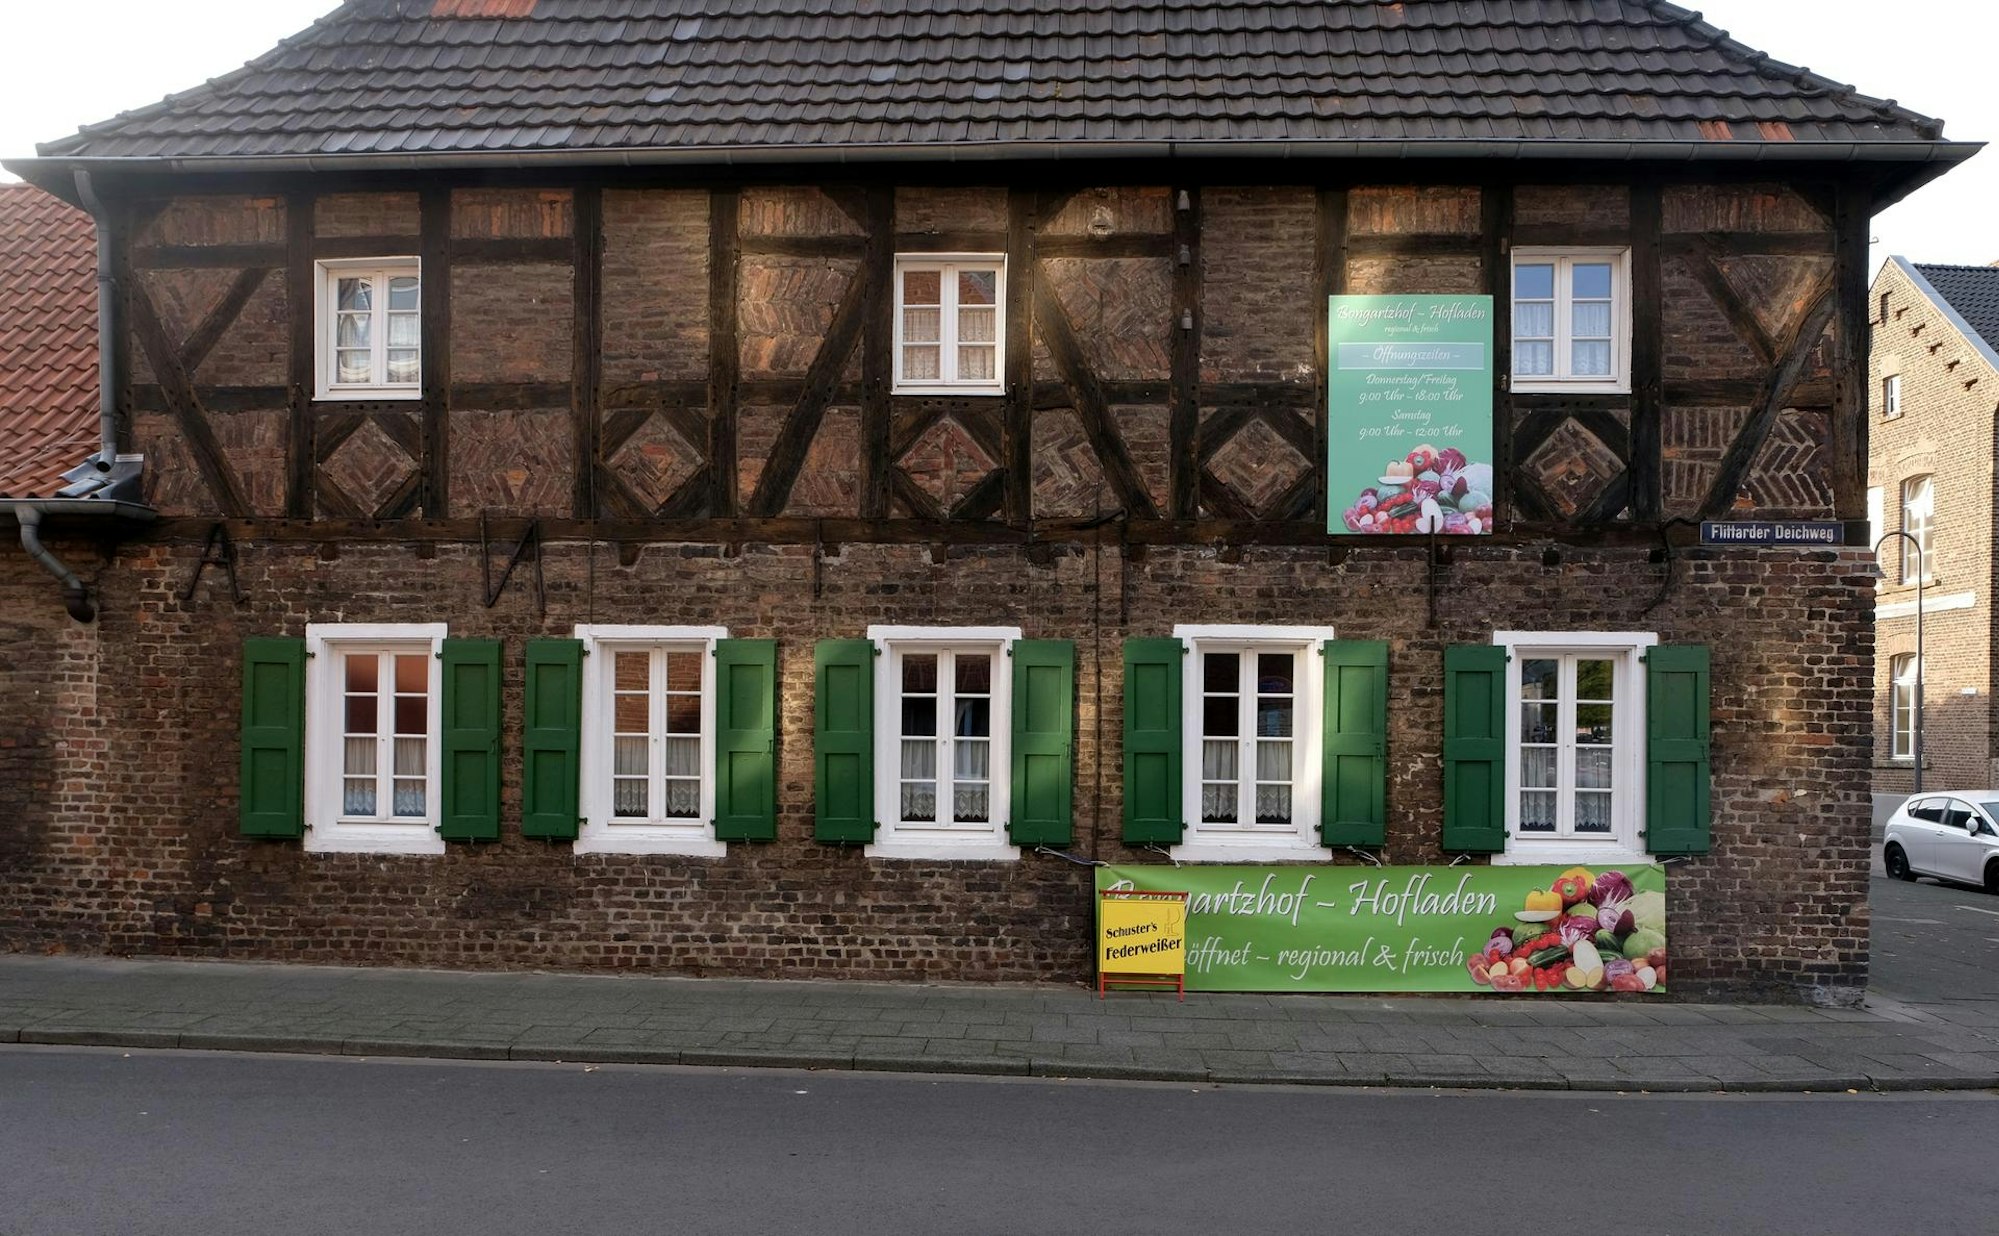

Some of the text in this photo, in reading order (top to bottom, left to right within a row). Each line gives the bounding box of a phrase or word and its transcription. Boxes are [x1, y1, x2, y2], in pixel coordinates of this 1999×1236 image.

[1337, 302, 1417, 327] Bongartzhof
[1430, 302, 1485, 323] Hofladen
[1384, 323, 1412, 336] regional
[1373, 345, 1450, 367] Öffnungszeiten
[1366, 373, 1457, 390] Donnerstag/Freitag
[1384, 388, 1405, 401] Uhr
[1415, 389, 1441, 401] 18:00
[1443, 388, 1464, 401] Uhr
[1392, 409, 1432, 426] Samstag
[1359, 427, 1381, 441] 9:00
[1384, 424, 1405, 437] Uhr
[1415, 427, 1440, 437] 12:00
[1443, 424, 1464, 437] Uhr
[1711, 524, 1834, 543] Flittarder Deichweg
[1107, 873, 1316, 927] artzhof
[1348, 872, 1497, 927] Hofladen
[1106, 937, 1183, 961] Federweißer
[1183, 936, 1252, 973] öffnet
[1277, 936, 1375, 981] regional
[1372, 944, 1397, 971] &
[1402, 936, 1464, 975] frisch
